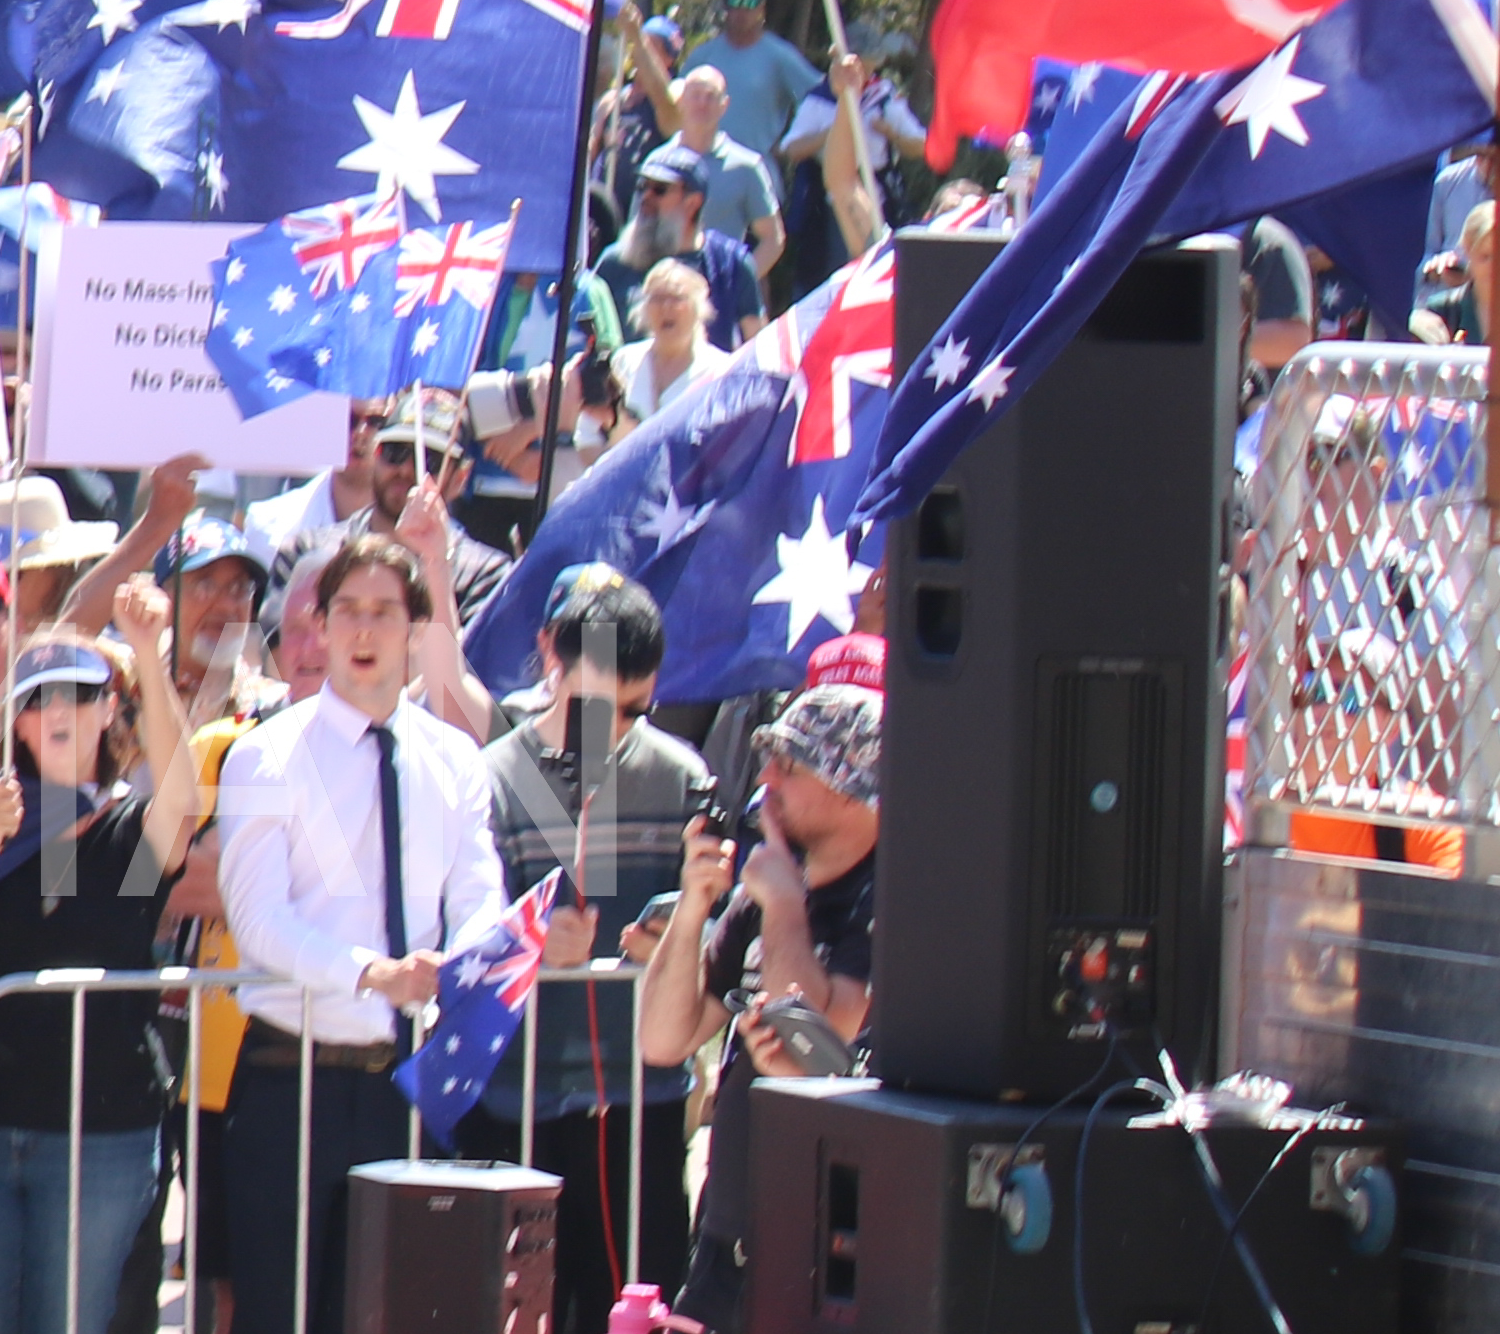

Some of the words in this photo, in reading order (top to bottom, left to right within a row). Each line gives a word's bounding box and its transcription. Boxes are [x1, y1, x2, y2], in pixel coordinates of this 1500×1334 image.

[84, 277, 117, 302] No
[122, 277, 215, 304] Mass-Im
[114, 322, 148, 348] No
[153, 322, 208, 349] Dicta
[130, 367, 163, 392] No
